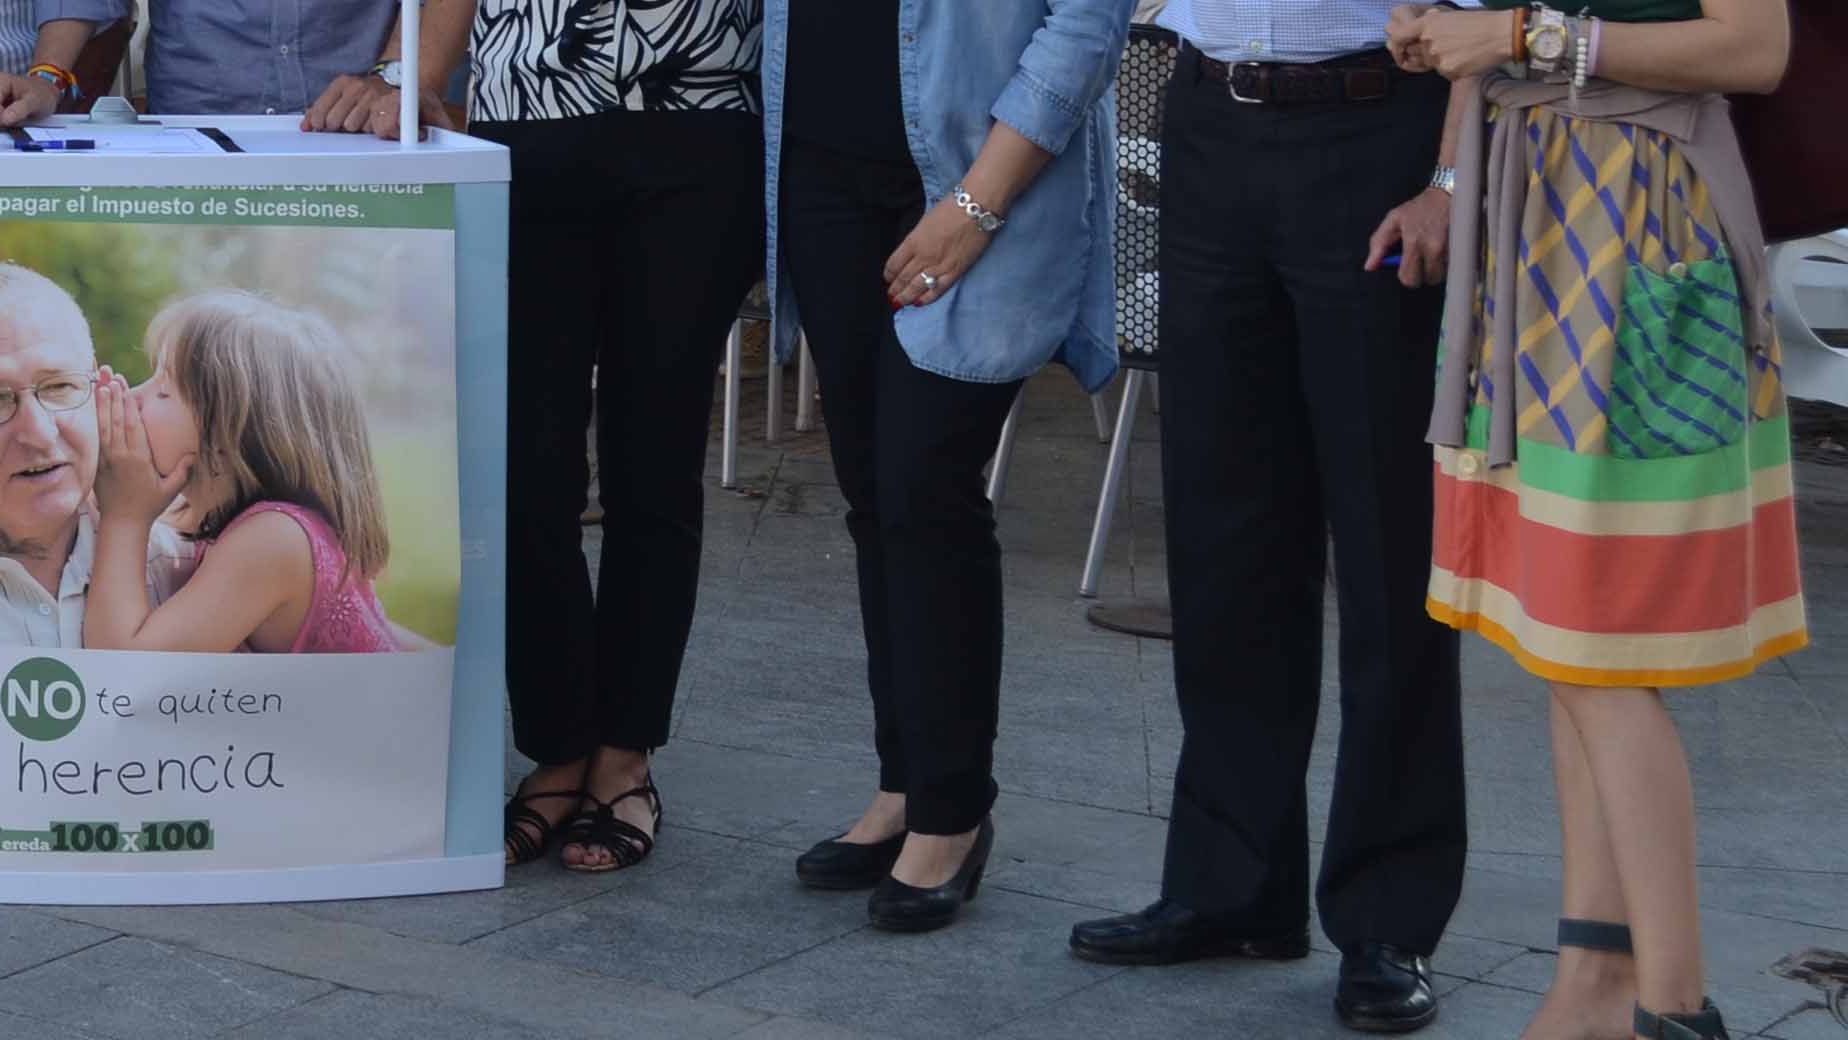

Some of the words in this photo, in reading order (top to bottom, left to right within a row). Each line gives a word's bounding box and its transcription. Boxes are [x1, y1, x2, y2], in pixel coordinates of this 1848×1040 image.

[66, 194, 85, 213] el
[92, 195, 194, 217] Impuesto
[202, 198, 227, 215] de
[235, 197, 366, 218] Sucesiones.
[7, 678, 82, 720] NO
[96, 687, 135, 718] te
[158, 688, 282, 724] quiten
[19, 742, 284, 795] herencia
